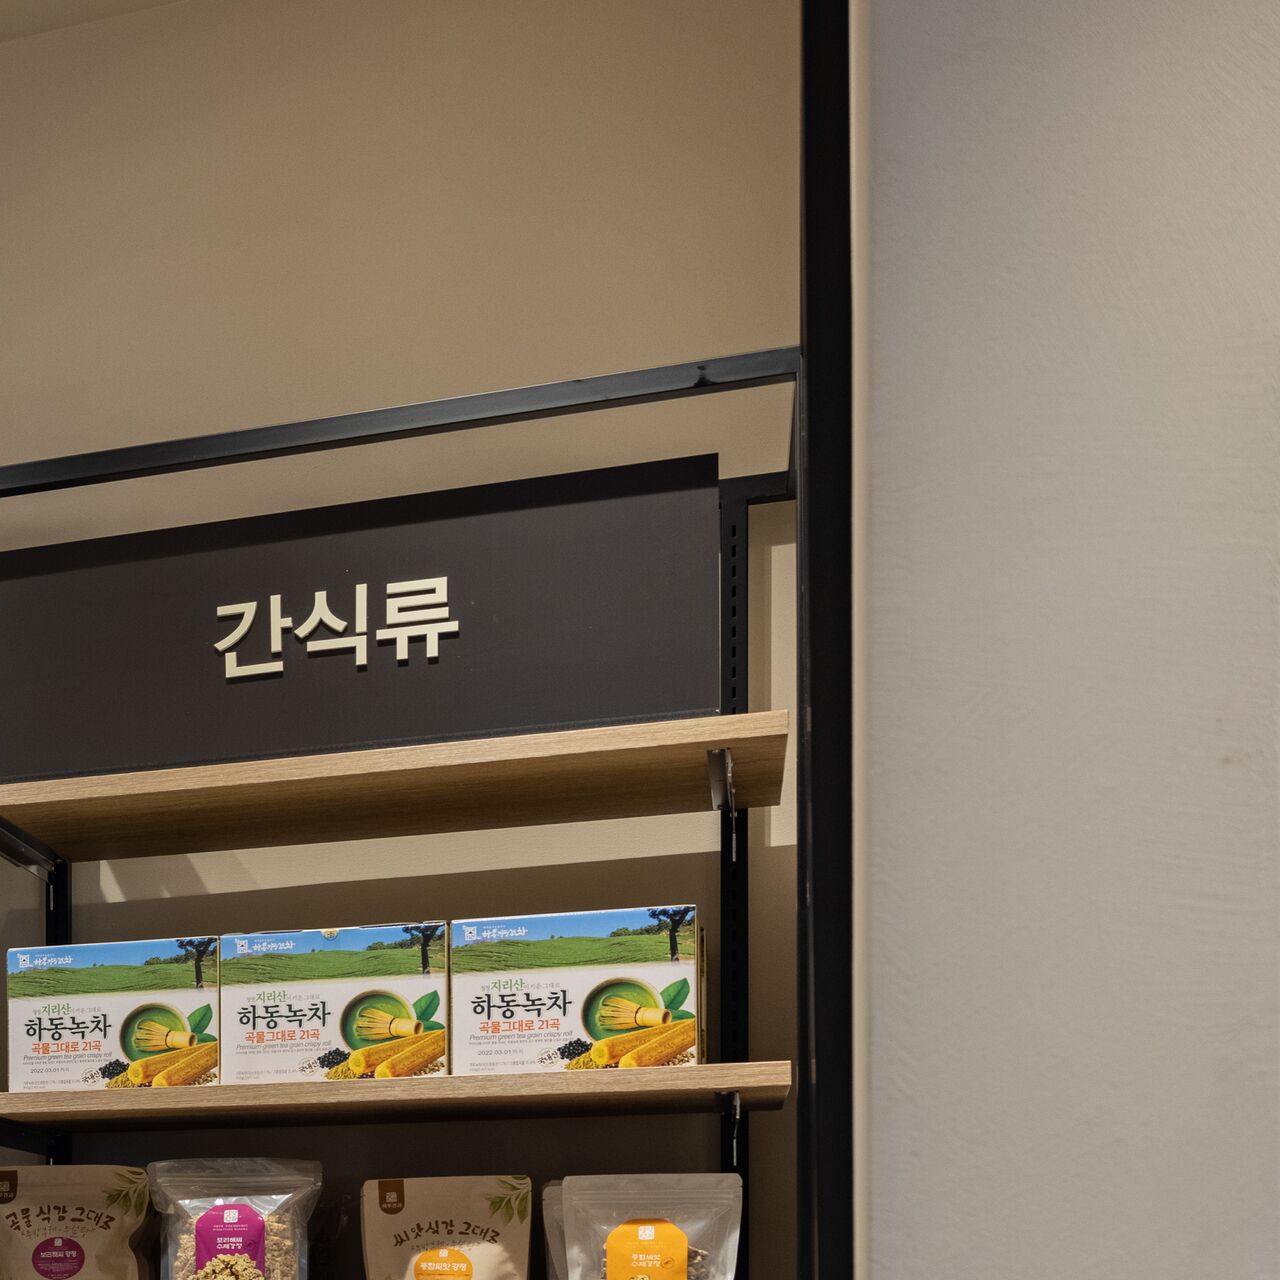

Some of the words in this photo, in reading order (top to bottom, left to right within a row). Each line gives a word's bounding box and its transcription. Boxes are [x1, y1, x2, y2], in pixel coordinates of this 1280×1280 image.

[214, 576, 460, 680] 간식류
[237, 1001, 331, 1030] 하동녹차
[471, 989, 572, 1020] 하동녹차
[24, 1014, 112, 1042] 하동녹차
[245, 1030, 297, 1043] 곡물그대로
[299, 1028, 321, 1040] 21곡
[479, 1020, 535, 1034] 곡물그대로
[538, 1018, 560, 1031] 21곡
[498, 1034, 515, 1042] green
[32, 1042, 80, 1055] 곡물그대로
[82, 1040, 102, 1052] 21곡
[5, 1207, 32, 1231] 곡물
[39, 1205, 67, 1221] 식감
[72, 1207, 115, 1231] 그대로
[462, 1221, 501, 1244] 그대로
